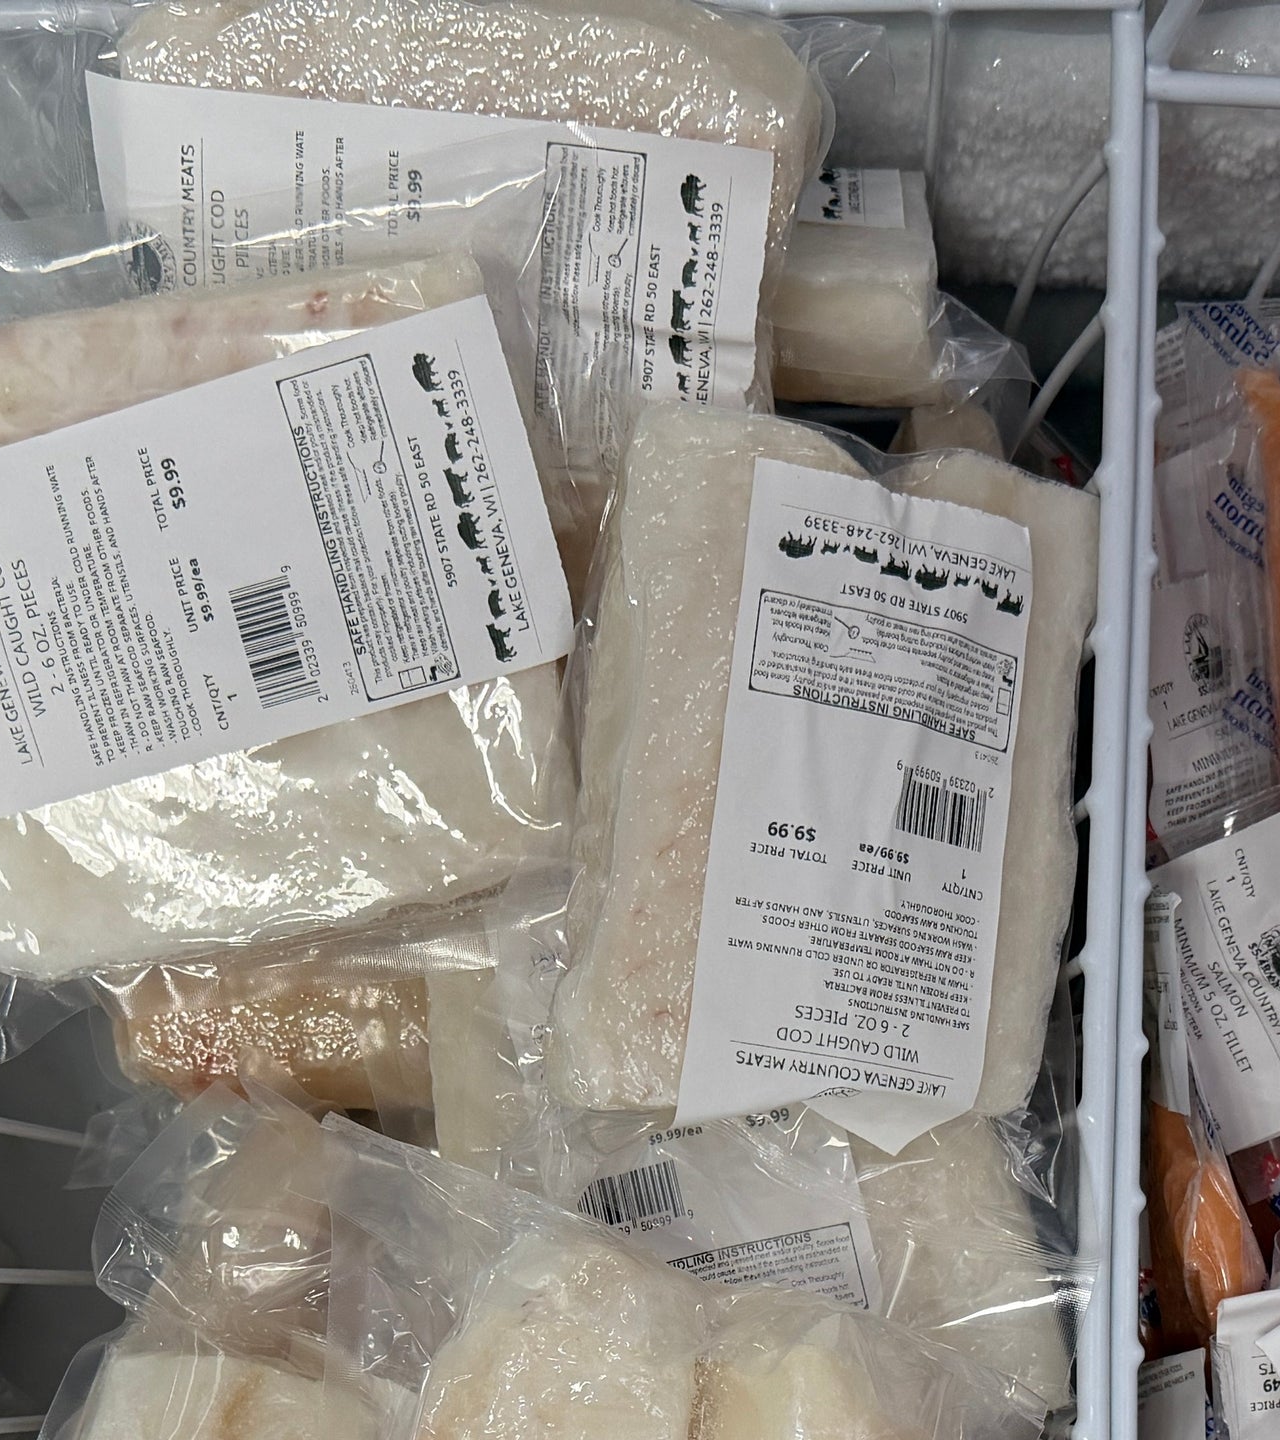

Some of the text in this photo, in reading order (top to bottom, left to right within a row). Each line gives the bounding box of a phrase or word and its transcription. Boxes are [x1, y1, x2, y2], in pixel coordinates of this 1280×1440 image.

[699, 201, 724, 318] 262-248-3339
[136, 445, 169, 533] TOTAL PRICE
[159, 456, 187, 510] $9.99
[405, 435, 458, 588] 5907 STATE RD 50 EAST
[446, 368, 530, 632] LAKE GENEVA, WI 262-248-3339
[292, 424, 367, 656] SAFE HANDLING INSTRUCTIONS
[802, 513, 901, 550] 262-248-3339
[9, 557, 41, 620] PIECES
[167, 556, 199, 634] UNIT PRICE
[188, 556, 215, 623] $9.99/ea
[30, 622, 51, 654] OZ.
[40, 655, 56, 669] 6
[286, 590, 322, 678] 02339 50999
[20, 669, 47, 718] WILD
[49, 681, 65, 696] 2
[143, 612, 191, 741] TOUCHING RAW SEAFOOD.
[201, 672, 230, 731] CNT/QTY
[225, 692, 238, 702] 1
[8, 724, 33, 765] LAKE
[748, 840, 828, 865] TOTAL PRICE
[766, 820, 817, 843] $9.99
[1205, 878, 1227, 916] LAKE
[1216, 915, 1248, 972] GENEVA
[1172, 916, 1254, 1073] MINIMUM 5 OZ. FILLET
[1206, 960, 1250, 1018] SALMON
[734, 1048, 947, 1098] LAKE GENEVA COUNTRY MEATS
[775, 1025, 919, 1064] WILD CAUGHT COD
